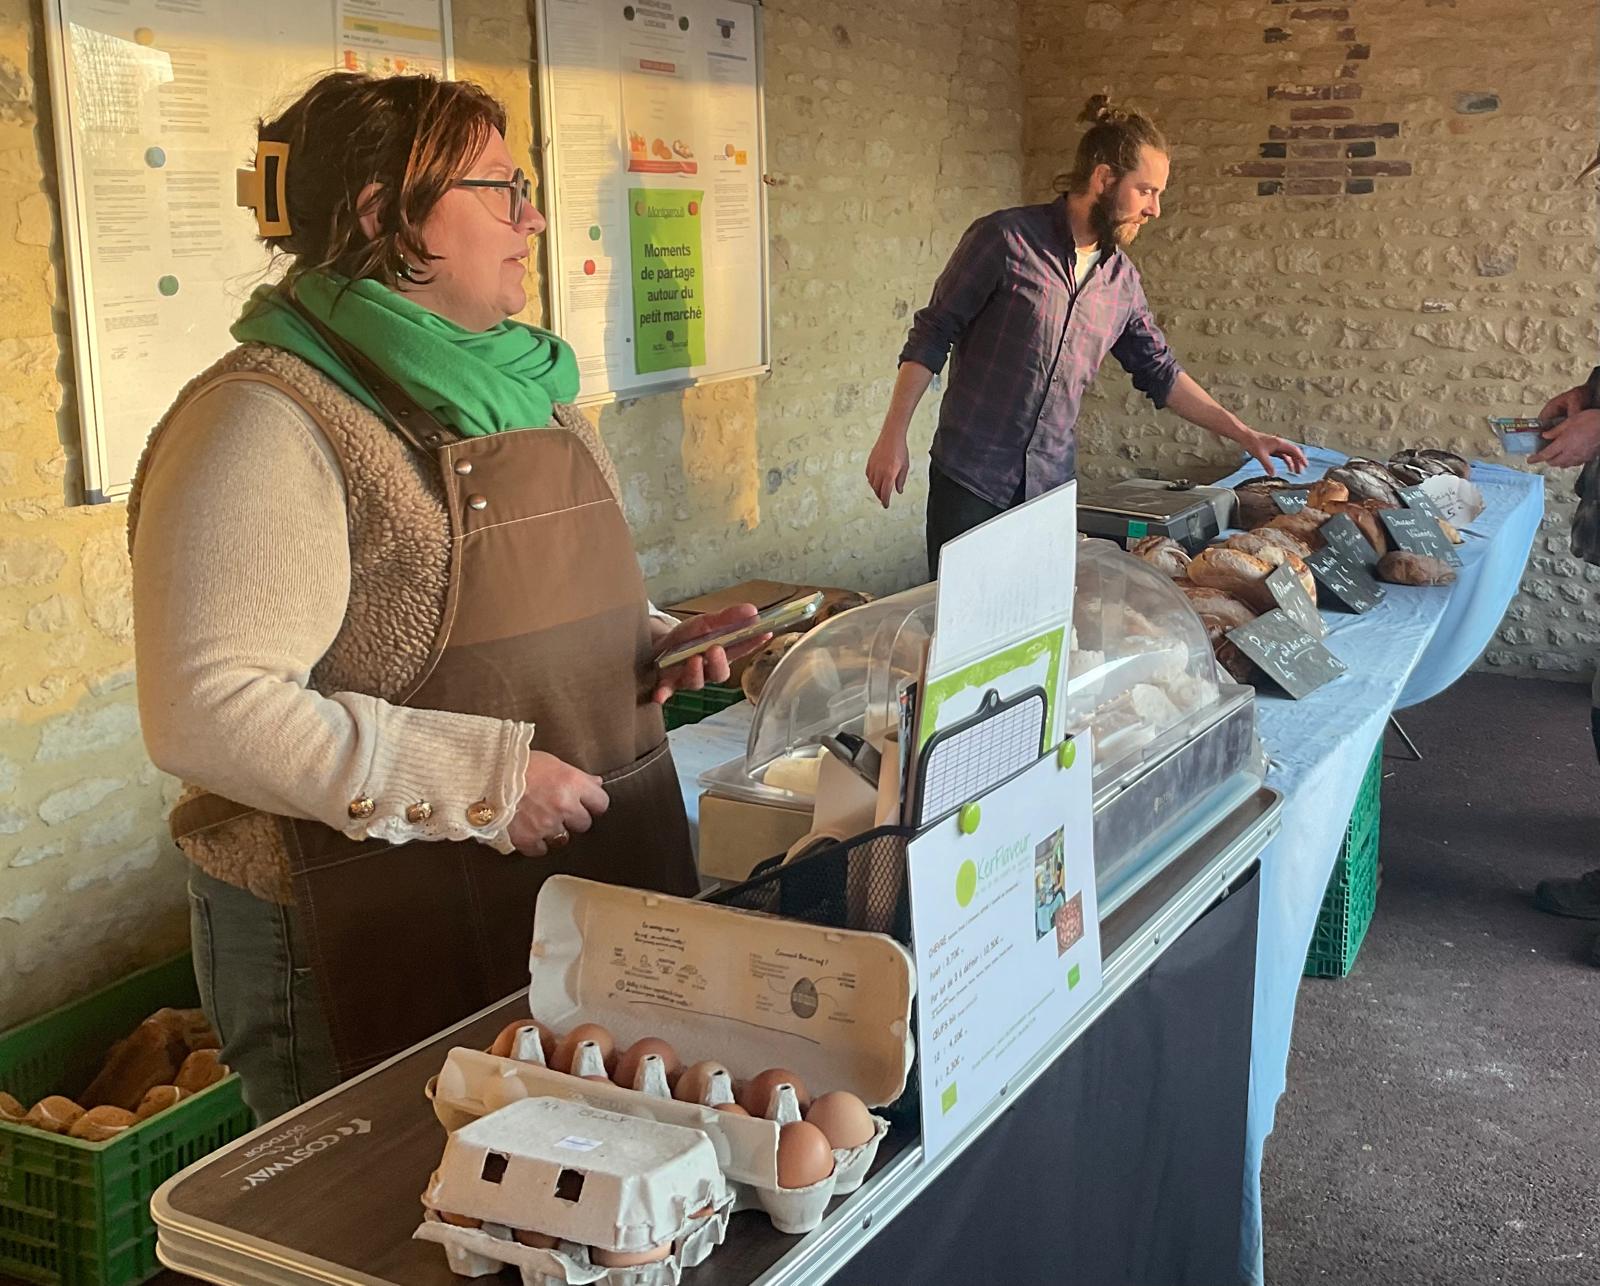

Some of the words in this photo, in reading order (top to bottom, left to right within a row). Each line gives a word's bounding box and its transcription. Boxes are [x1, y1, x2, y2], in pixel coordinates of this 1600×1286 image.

[644, 243, 691, 258] Moments
[641, 267, 654, 280] de
[657, 265, 695, 282] partage
[648, 287, 679, 302] autour
[681, 286, 694, 299] du
[640, 309, 661, 328] petit
[664, 306, 702, 322] marché
[244, 1124, 306, 1158] OUTDOOR
[244, 1134, 340, 1187] COSTWAY
